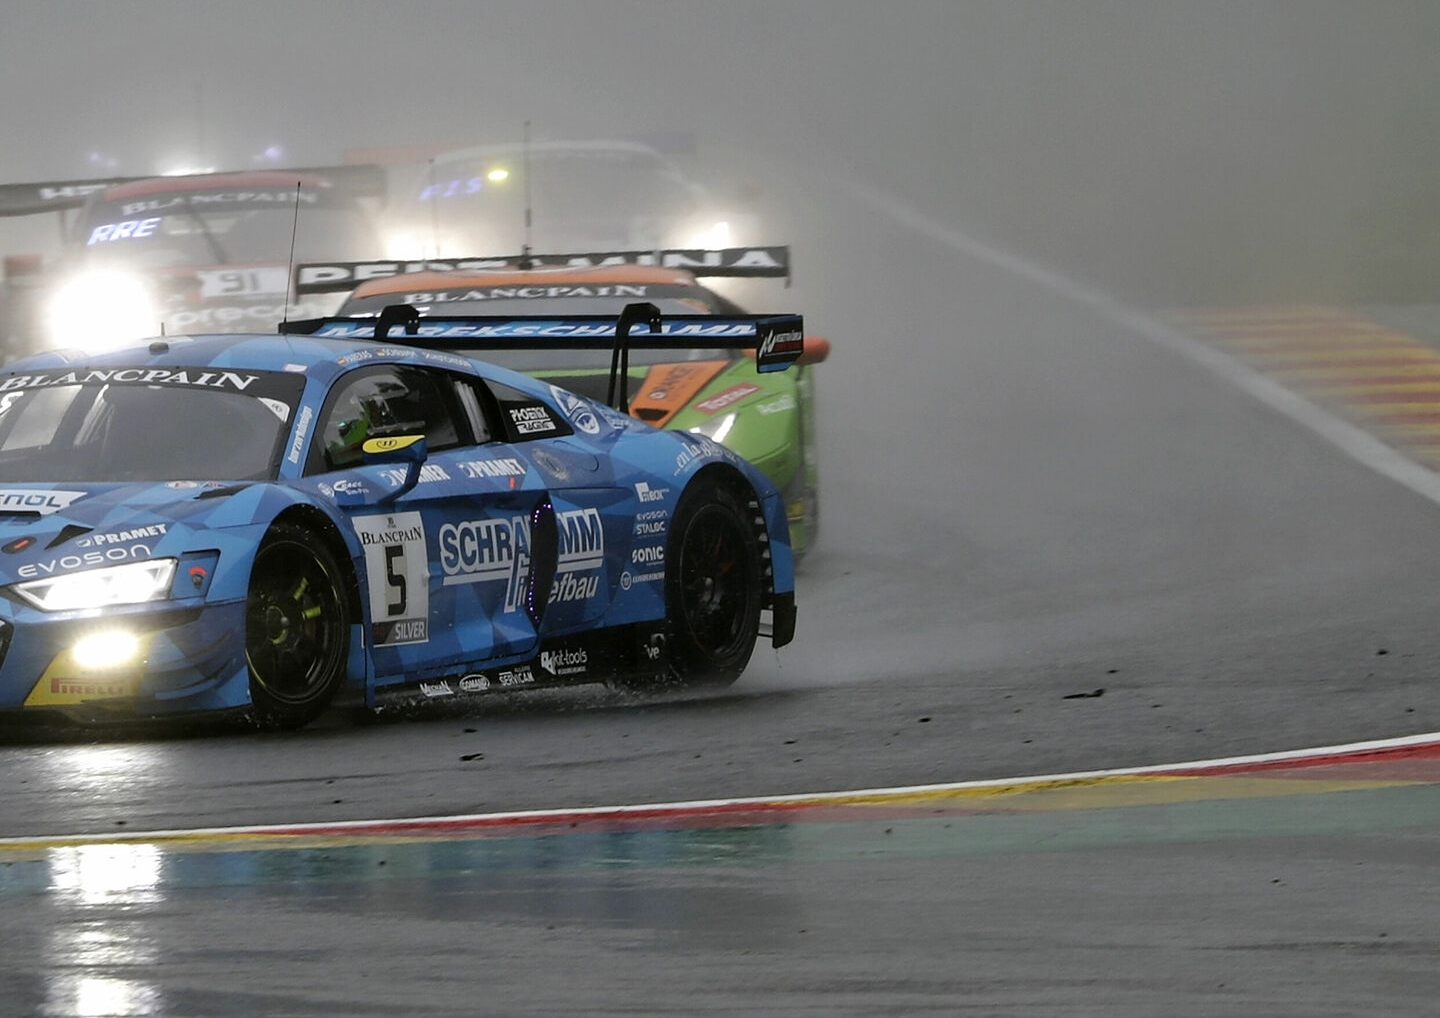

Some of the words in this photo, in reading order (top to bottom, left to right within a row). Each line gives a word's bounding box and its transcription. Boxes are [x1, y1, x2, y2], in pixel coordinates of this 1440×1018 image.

[122, 192, 318, 215] BLANCPAIN
[87, 217, 161, 246] RRE
[220, 270, 258, 292] 91
[404, 285, 648, 304] BLANCPAIN
[392, 464, 451, 485] DOMER
[473, 459, 526, 478] PRAMET
[95, 523, 168, 546] PRAMET
[361, 526, 422, 545] BLANCPAIN
[637, 521, 666, 535] STALOC
[440, 509, 604, 575] SCHRAMM
[18, 544, 151, 578] EVOSON
[632, 545, 665, 563] SONIC
[385, 545, 407, 616] 5
[395, 622, 425, 640] SILVER
[51, 677, 124, 694] PIRELLI
